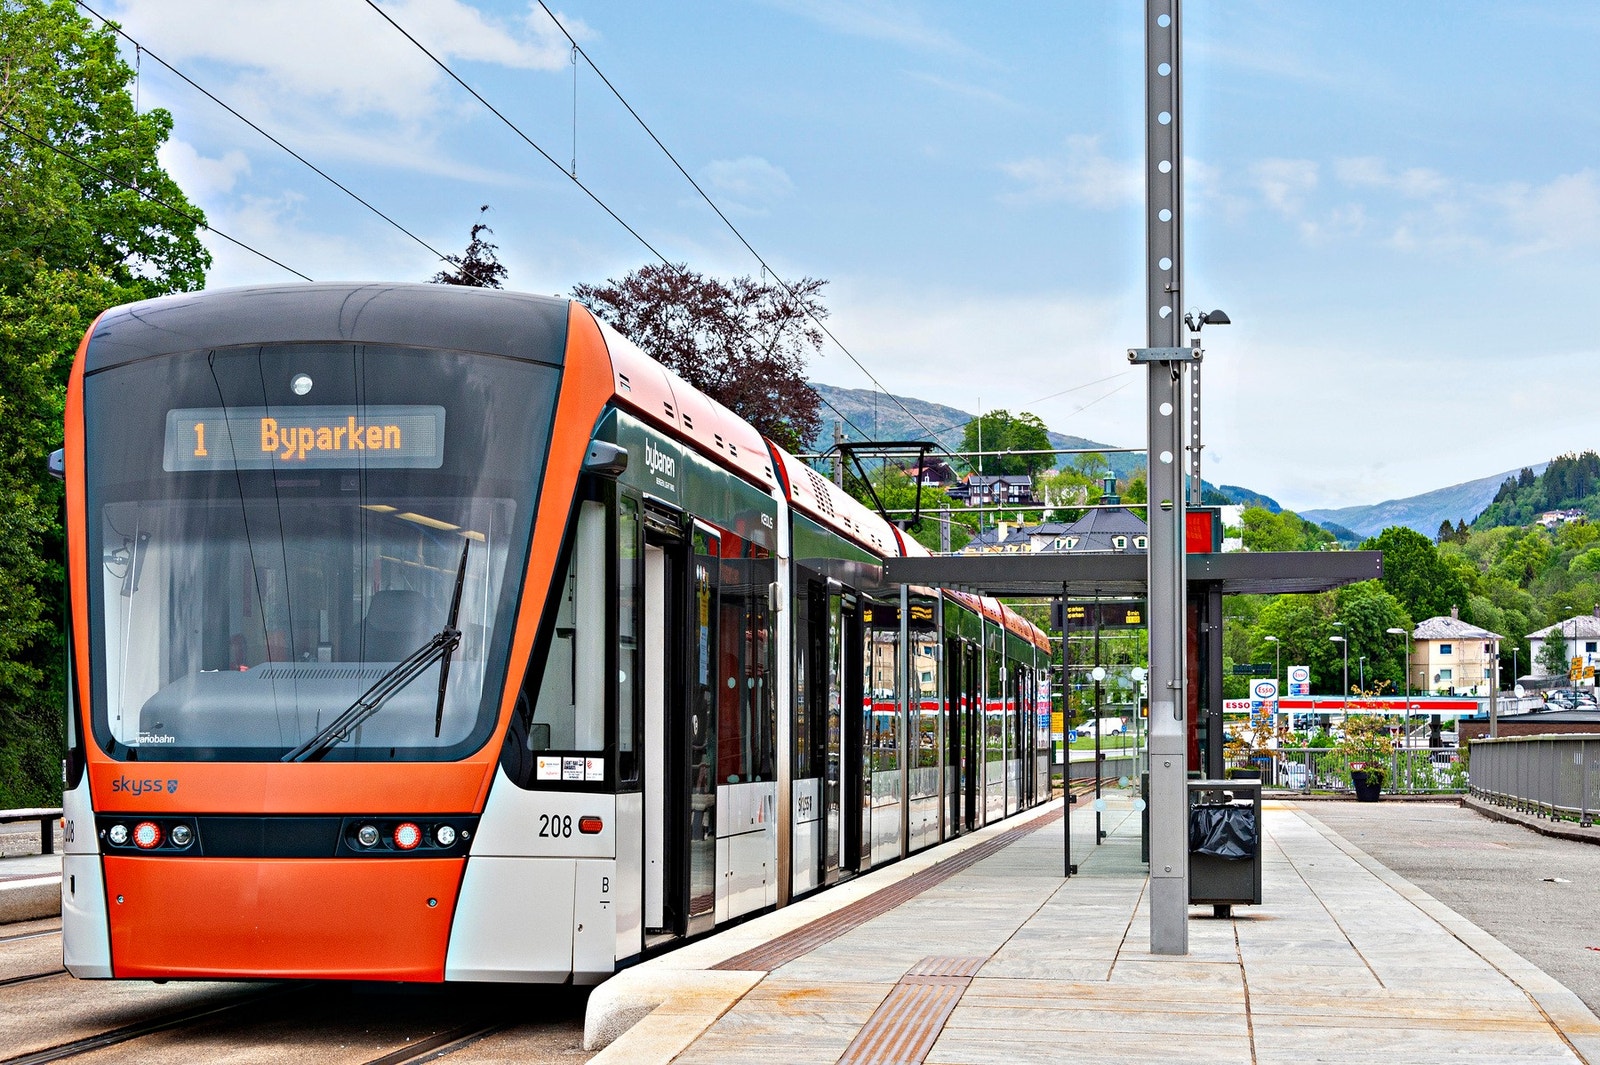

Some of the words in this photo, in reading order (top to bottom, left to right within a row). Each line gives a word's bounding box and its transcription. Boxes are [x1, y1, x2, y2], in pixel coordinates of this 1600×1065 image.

[194, 423, 207, 456] 1
[261, 416, 401, 460] Byparken
[645, 437, 675, 478] bybanen
[135, 734, 175, 744] variobahn
[112, 775, 163, 796] skyss
[539, 814, 572, 838] 208
[602, 877, 609, 893] B
